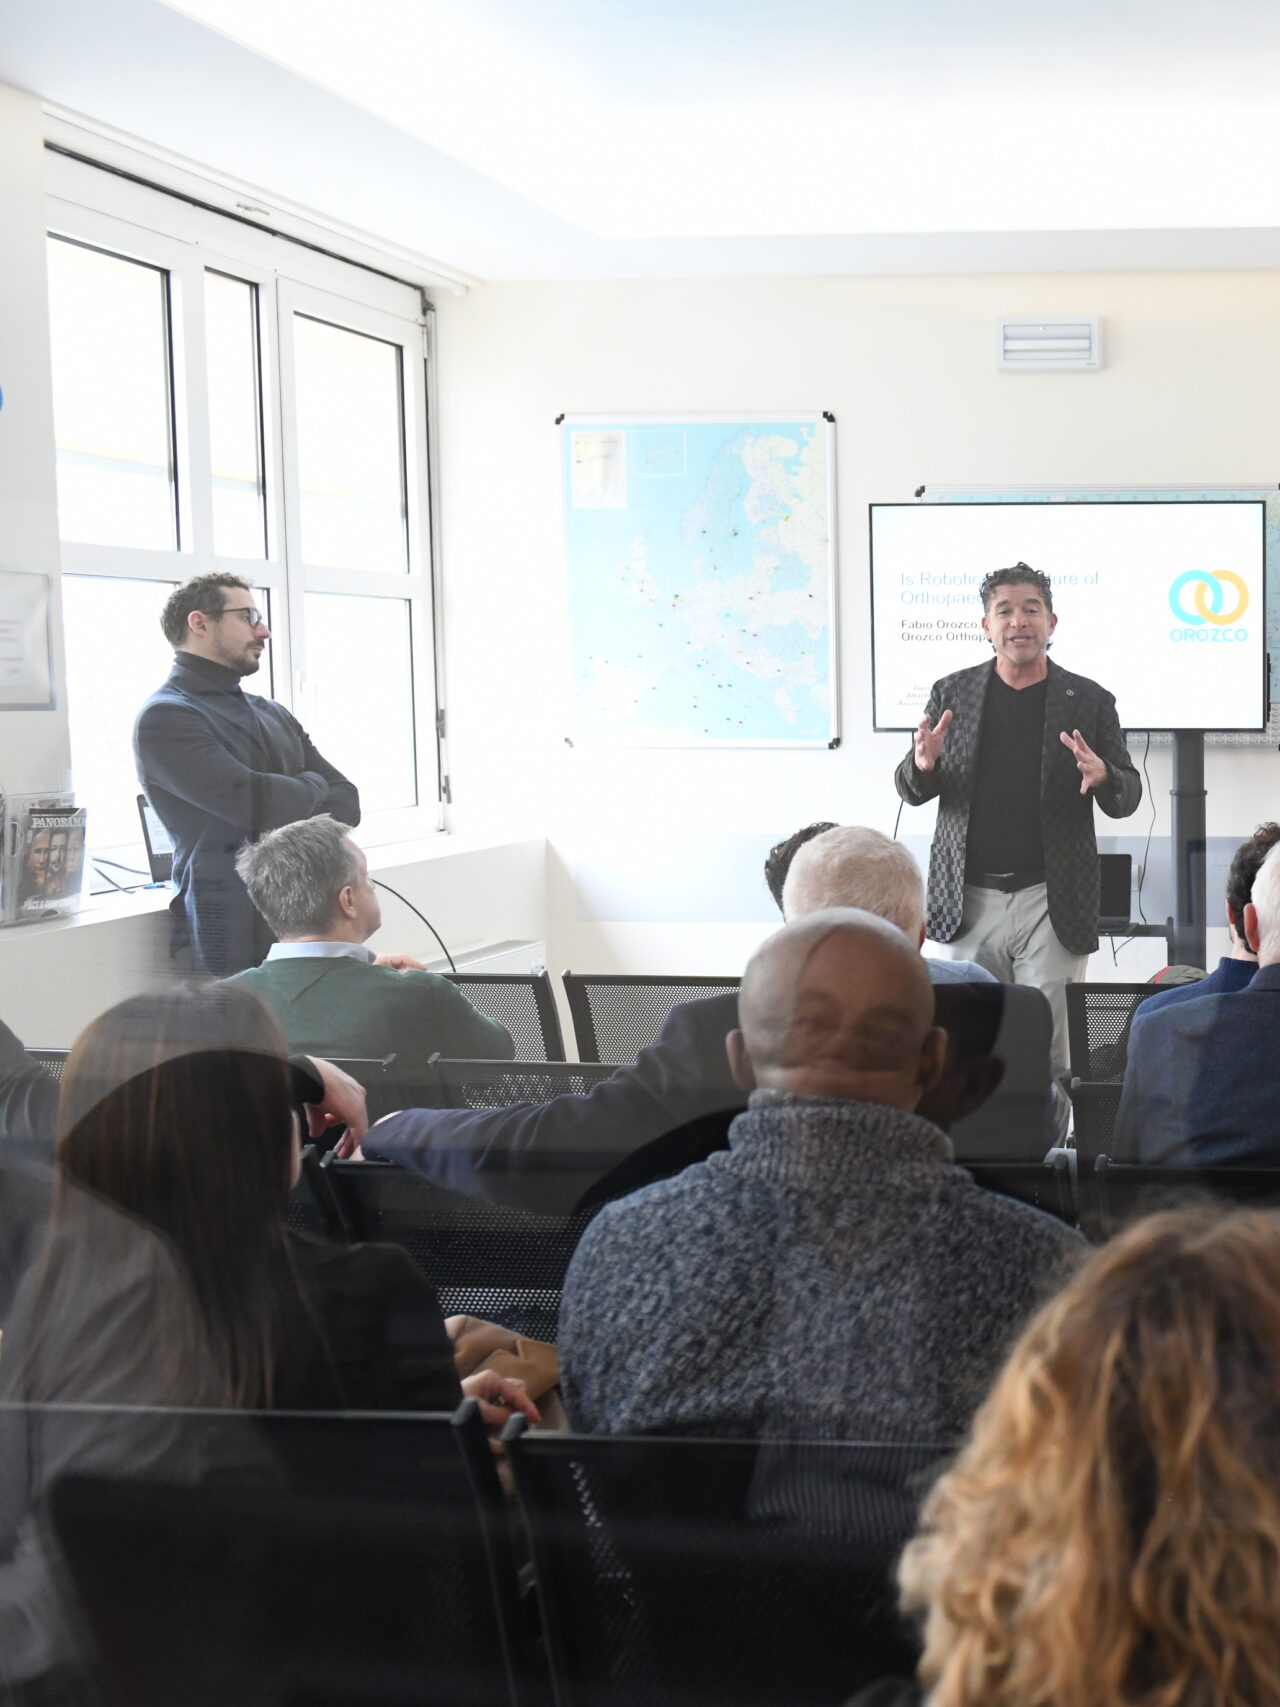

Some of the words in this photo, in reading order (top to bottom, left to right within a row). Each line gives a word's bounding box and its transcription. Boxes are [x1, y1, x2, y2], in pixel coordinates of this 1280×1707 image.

[901, 572, 914, 586] Is
[920, 572, 986, 586] Robotic
[1084, 571, 1099, 585] of
[901, 620, 933, 629] Fabio
[936, 620, 981, 630] Orozco,
[901, 632, 943, 641] Orozco
[946, 632, 988, 643] Orthop
[1170, 628, 1248, 642] OROZCO
